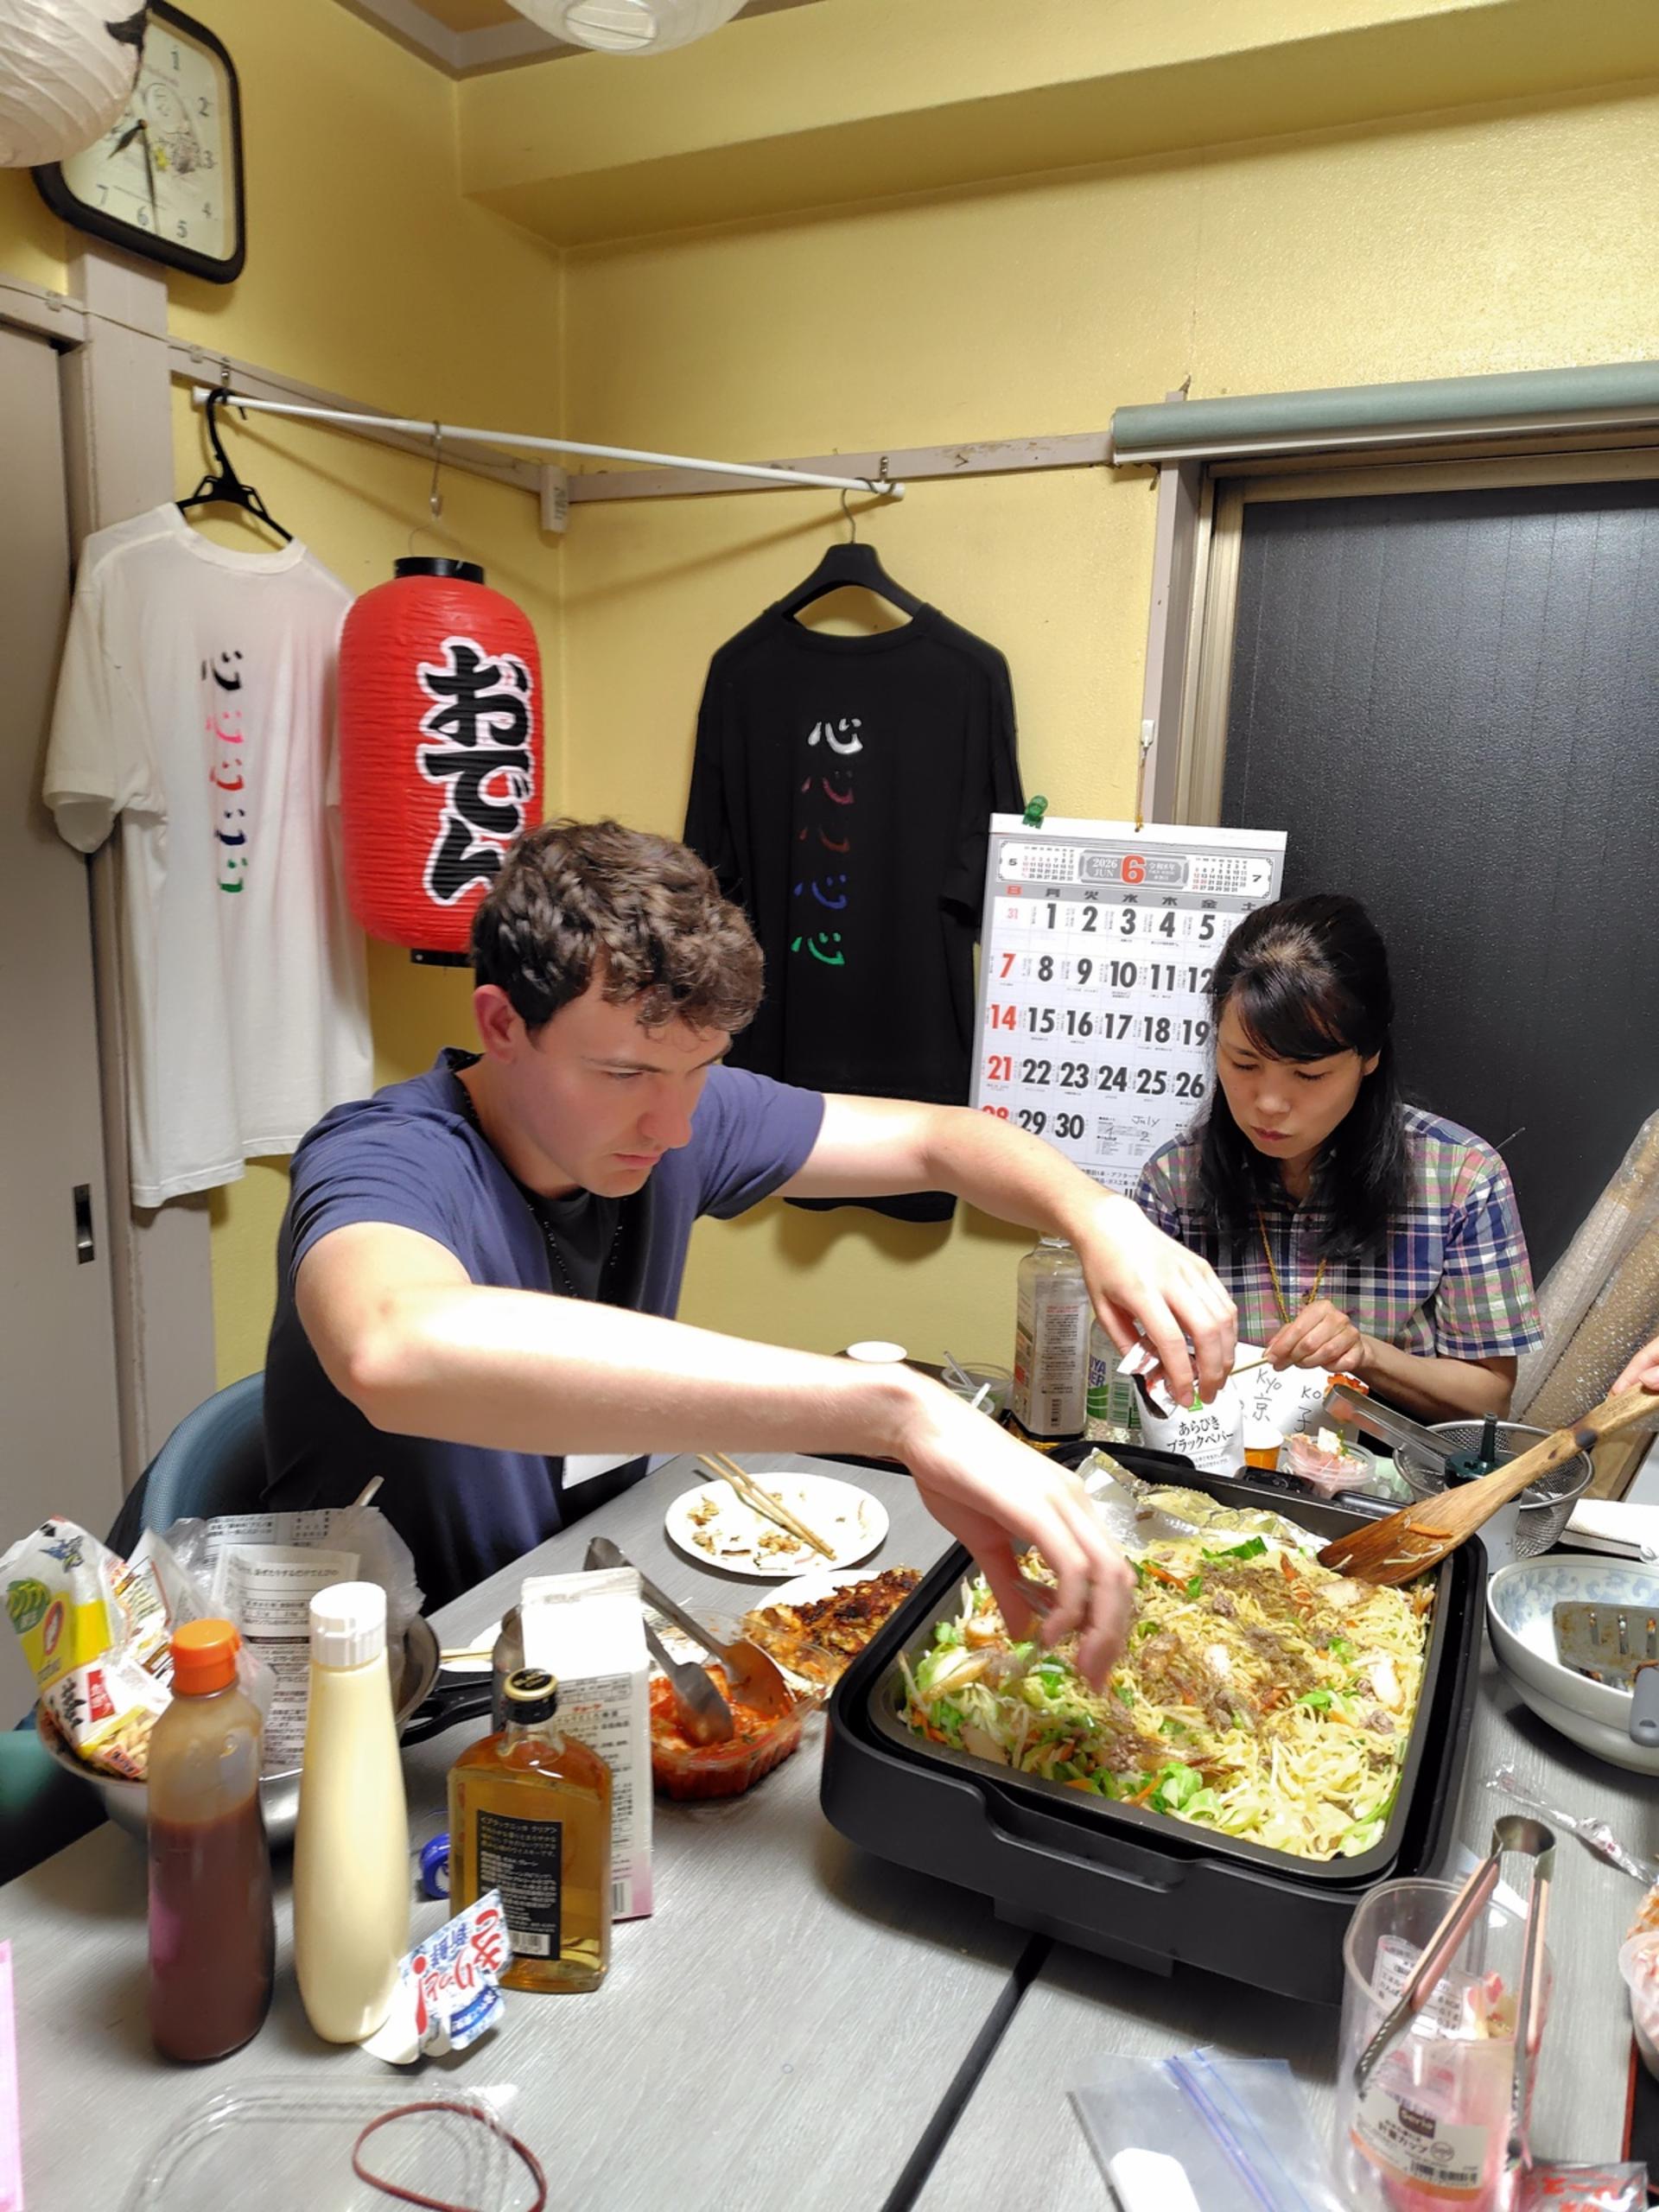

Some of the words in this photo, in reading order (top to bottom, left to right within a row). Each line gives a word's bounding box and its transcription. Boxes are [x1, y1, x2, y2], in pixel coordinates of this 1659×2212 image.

[172, 49, 180, 71] 1
[199, 97, 209, 117] 2
[137, 206, 149, 226] 6
[177, 219, 188, 238] 5
[419, 639, 532, 904] おでん
[1092, 858, 1117, 868] 2026
[1122, 855, 1145, 884] 6
[1007, 885, 1021, 895] 日
[1046, 888, 1060, 898] 月
[1084, 891, 1099, 900] 火
[1122, 893, 1138, 904] 水
[1161, 896, 1178, 906] 木
[1201, 899, 1217, 909] 金
[1243, 902, 1256, 911] 土
[1007, 908, 1018, 919] 31
[1047, 903, 1057, 929] 1
[1082, 906, 1098, 932] 2
[1120, 908, 1136, 935] 3
[1160, 912, 1175, 938] 4
[1198, 914, 1216, 940] 5
[999, 953, 1016, 978] 7
[1038, 955, 1053, 982] 8
[1077, 958, 1093, 984] 9
[1110, 961, 1137, 988] 10
[1151, 963, 1176, 991] 11
[1188, 966, 1212, 994] 12
[989, 1004, 1016, 1031] 14
[1028, 1007, 1056, 1033] 15
[1066, 1009, 1093, 1037] 16
[1104, 1013, 1134, 1040] 17
[1143, 1016, 1171, 1044] 18
[1183, 1019, 1209, 1046] 19
[988, 1055, 1014, 1081] 21
[1021, 1058, 1052, 1085] 22
[1059, 1061, 1090, 1090] 23
[1097, 1065, 1128, 1093] 24
[1136, 1068, 1166, 1096] 25
[1175, 1071, 1205, 1099] 26
[1018, 1109, 1047, 1135] 29
[1055, 1113, 1084, 1141] 30
[1132, 1116, 1160, 1127] July
[1140, 1131, 1151, 1141] 2
[1256, 1369, 1282, 1394] Kyo
[1252, 1392, 1273, 1422] 京
[1294, 1406, 1313, 1433] 子
[1179, 1415, 1220, 1436] あらびき
